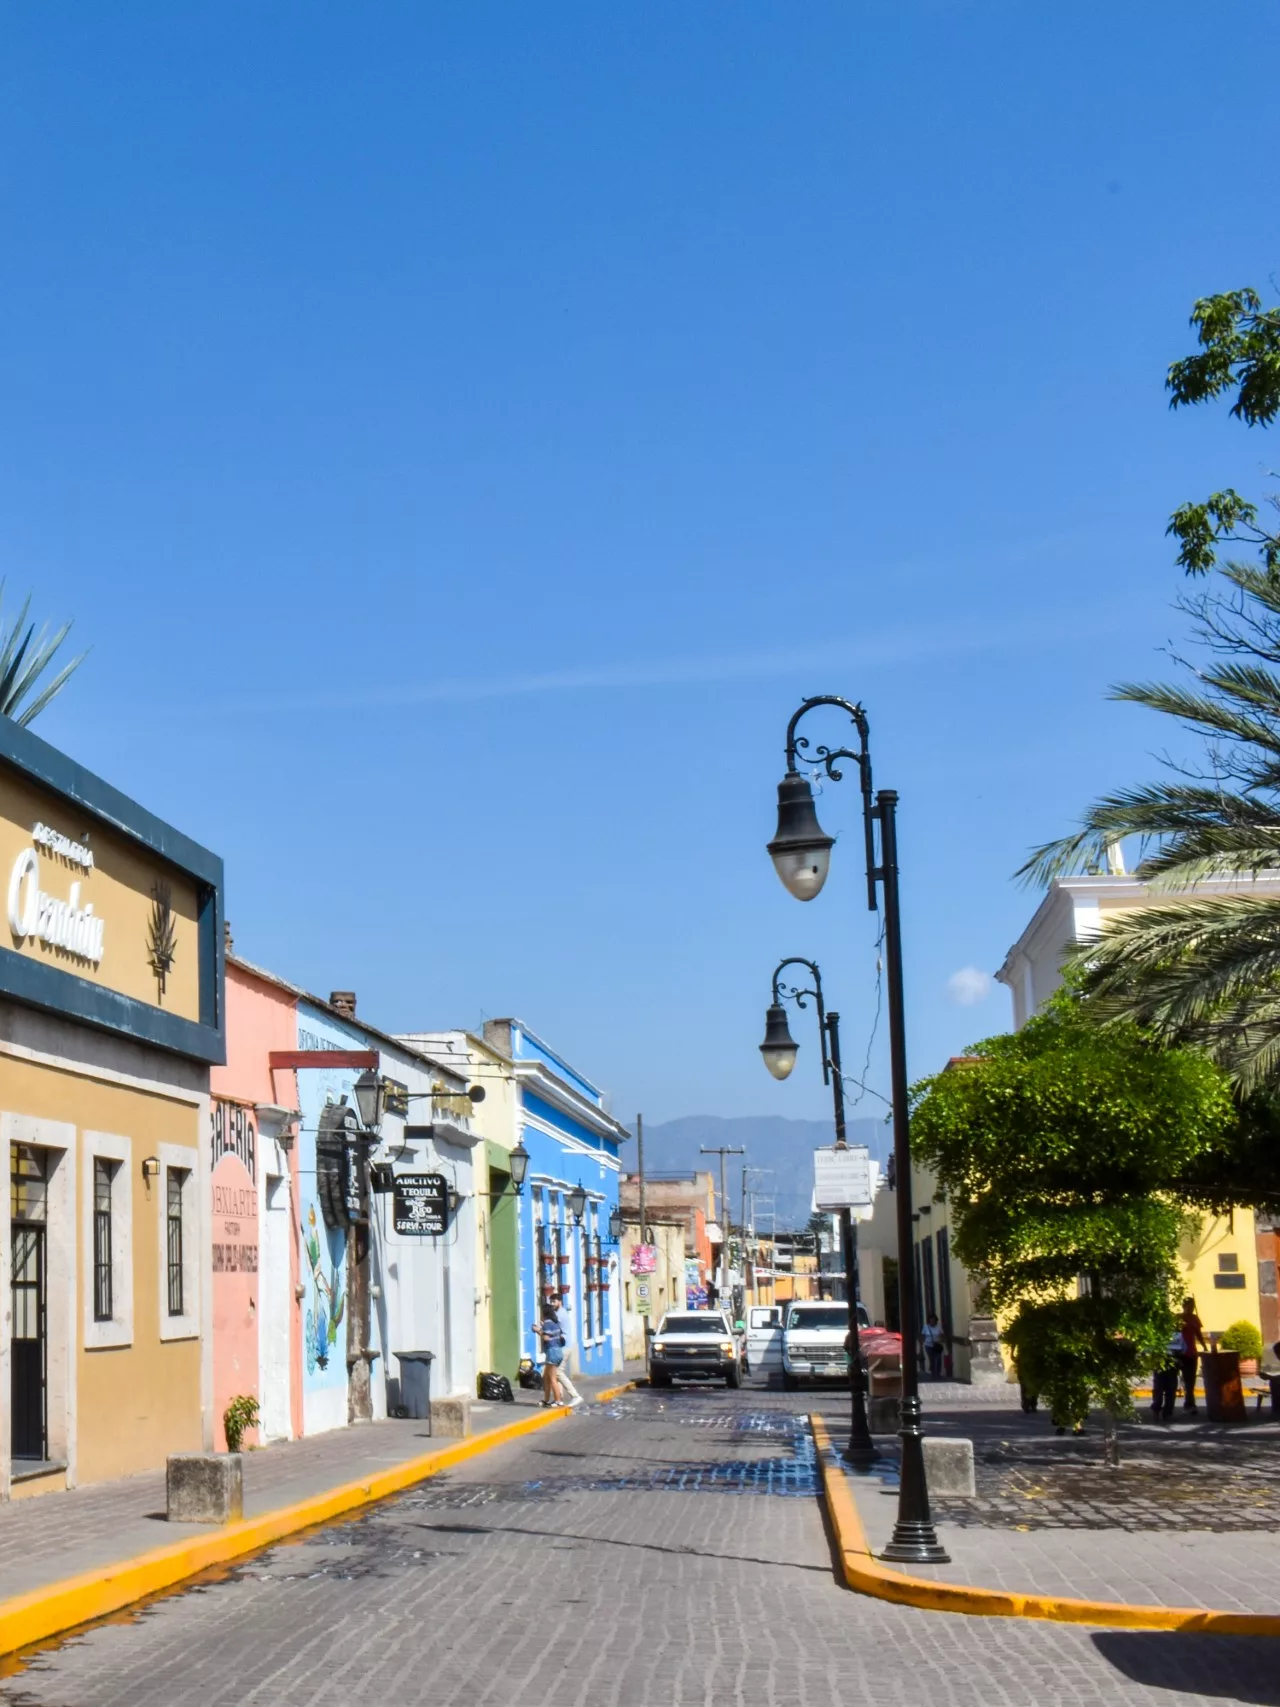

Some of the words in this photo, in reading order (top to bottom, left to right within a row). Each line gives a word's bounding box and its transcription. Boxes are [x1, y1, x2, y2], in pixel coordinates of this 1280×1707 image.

[395, 1176, 441, 1185] ADICTIVO
[400, 1187, 439, 1197] TEQUILA
[639, 1286, 646, 1296] E
